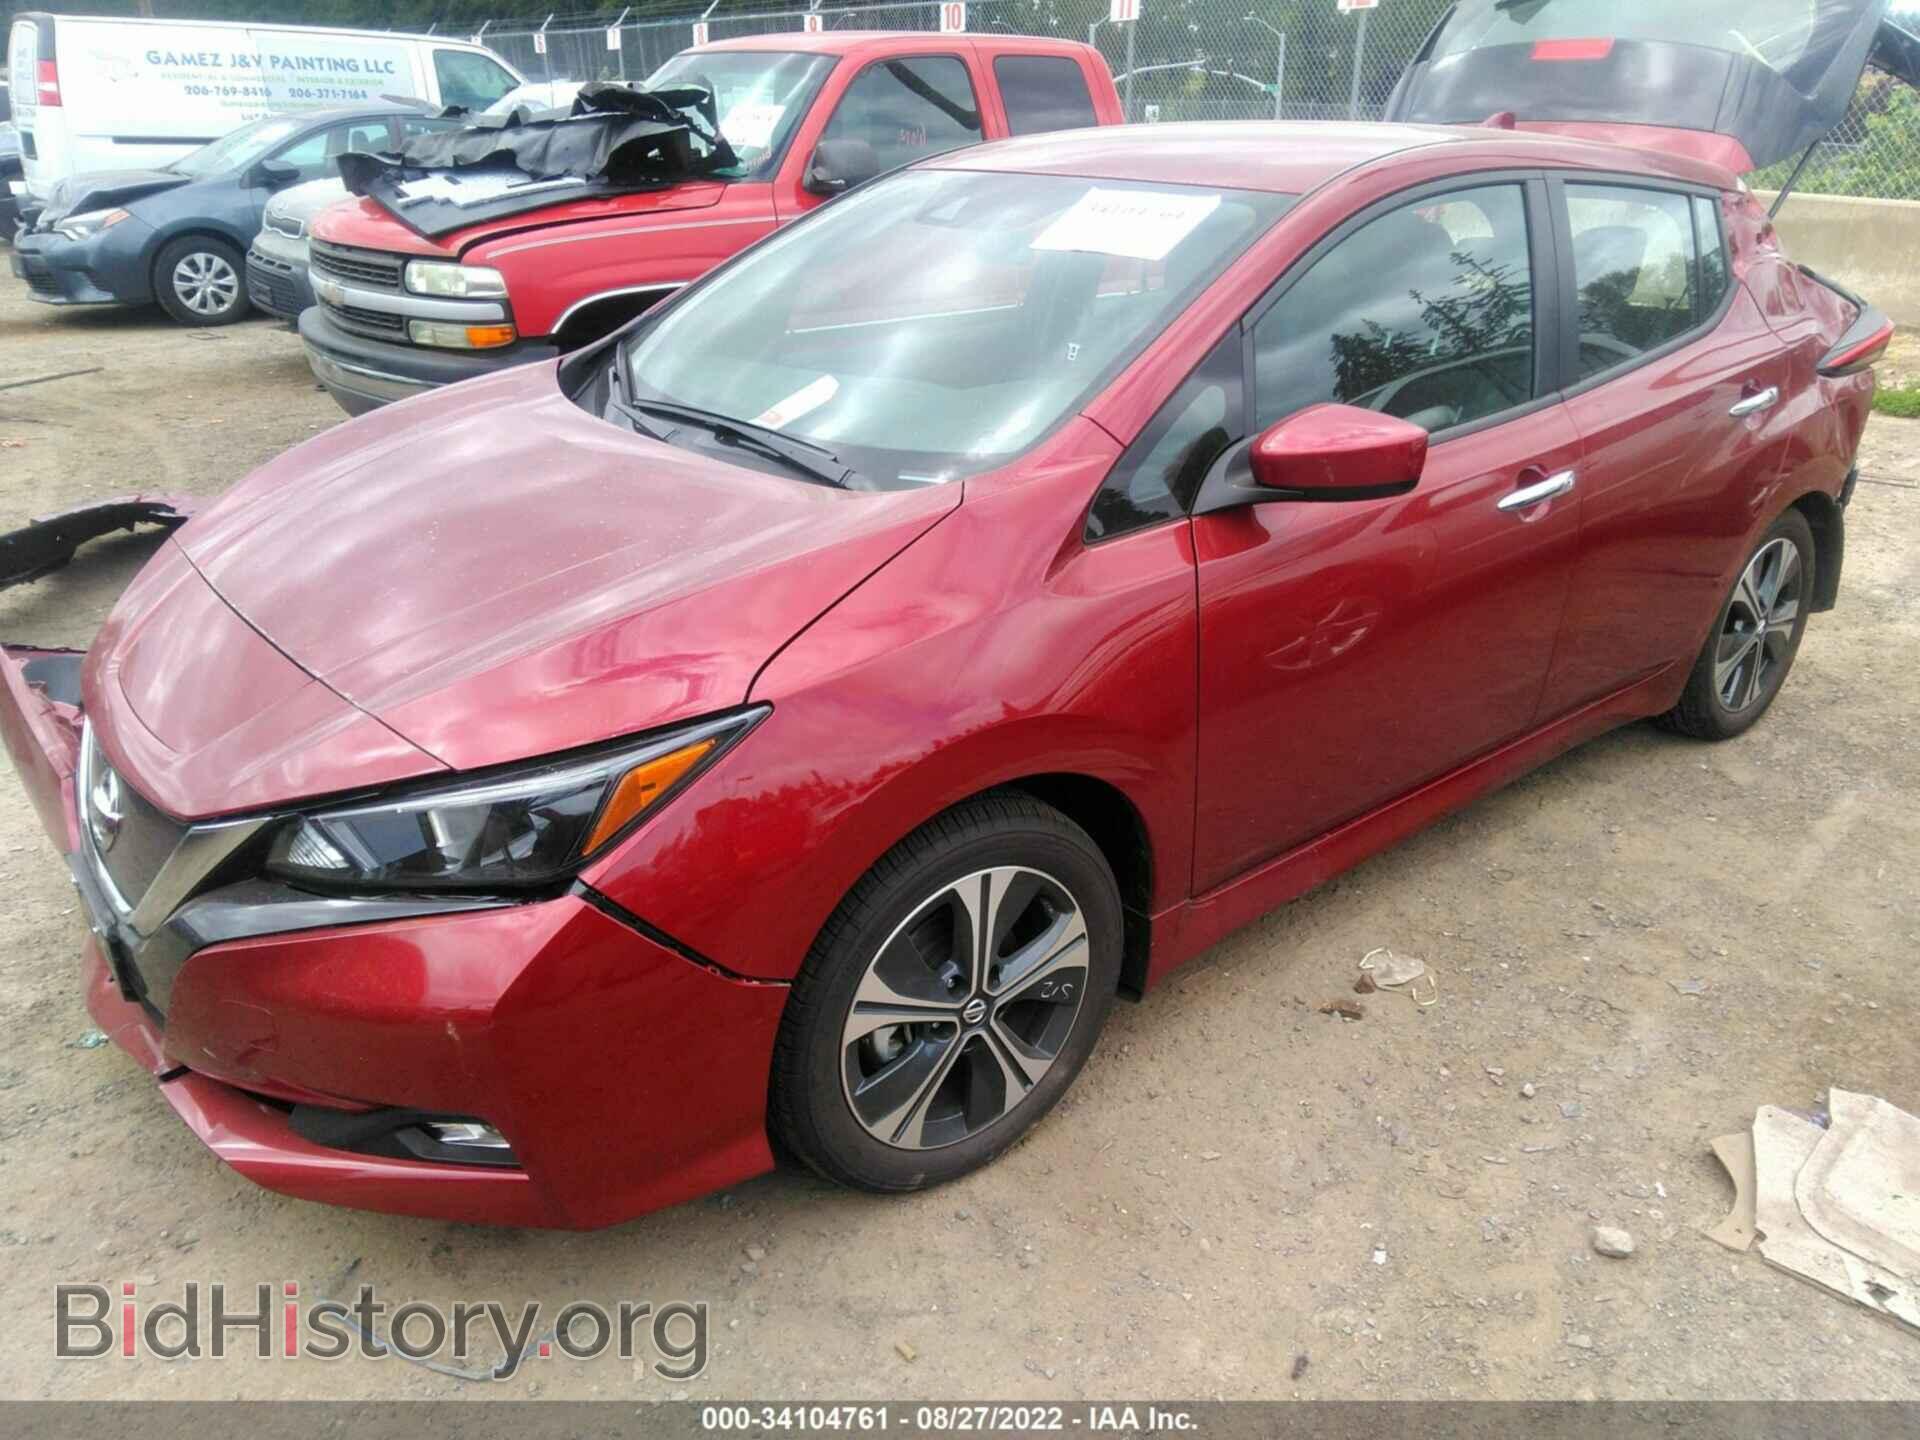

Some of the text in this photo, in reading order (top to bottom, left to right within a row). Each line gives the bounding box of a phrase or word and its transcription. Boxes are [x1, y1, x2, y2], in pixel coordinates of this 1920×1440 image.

[944, 3, 961, 30] 10
[146, 50, 395, 74] GAMEZ J&V PAINTING LLC
[184, 85, 272, 97] 206-769-8416
